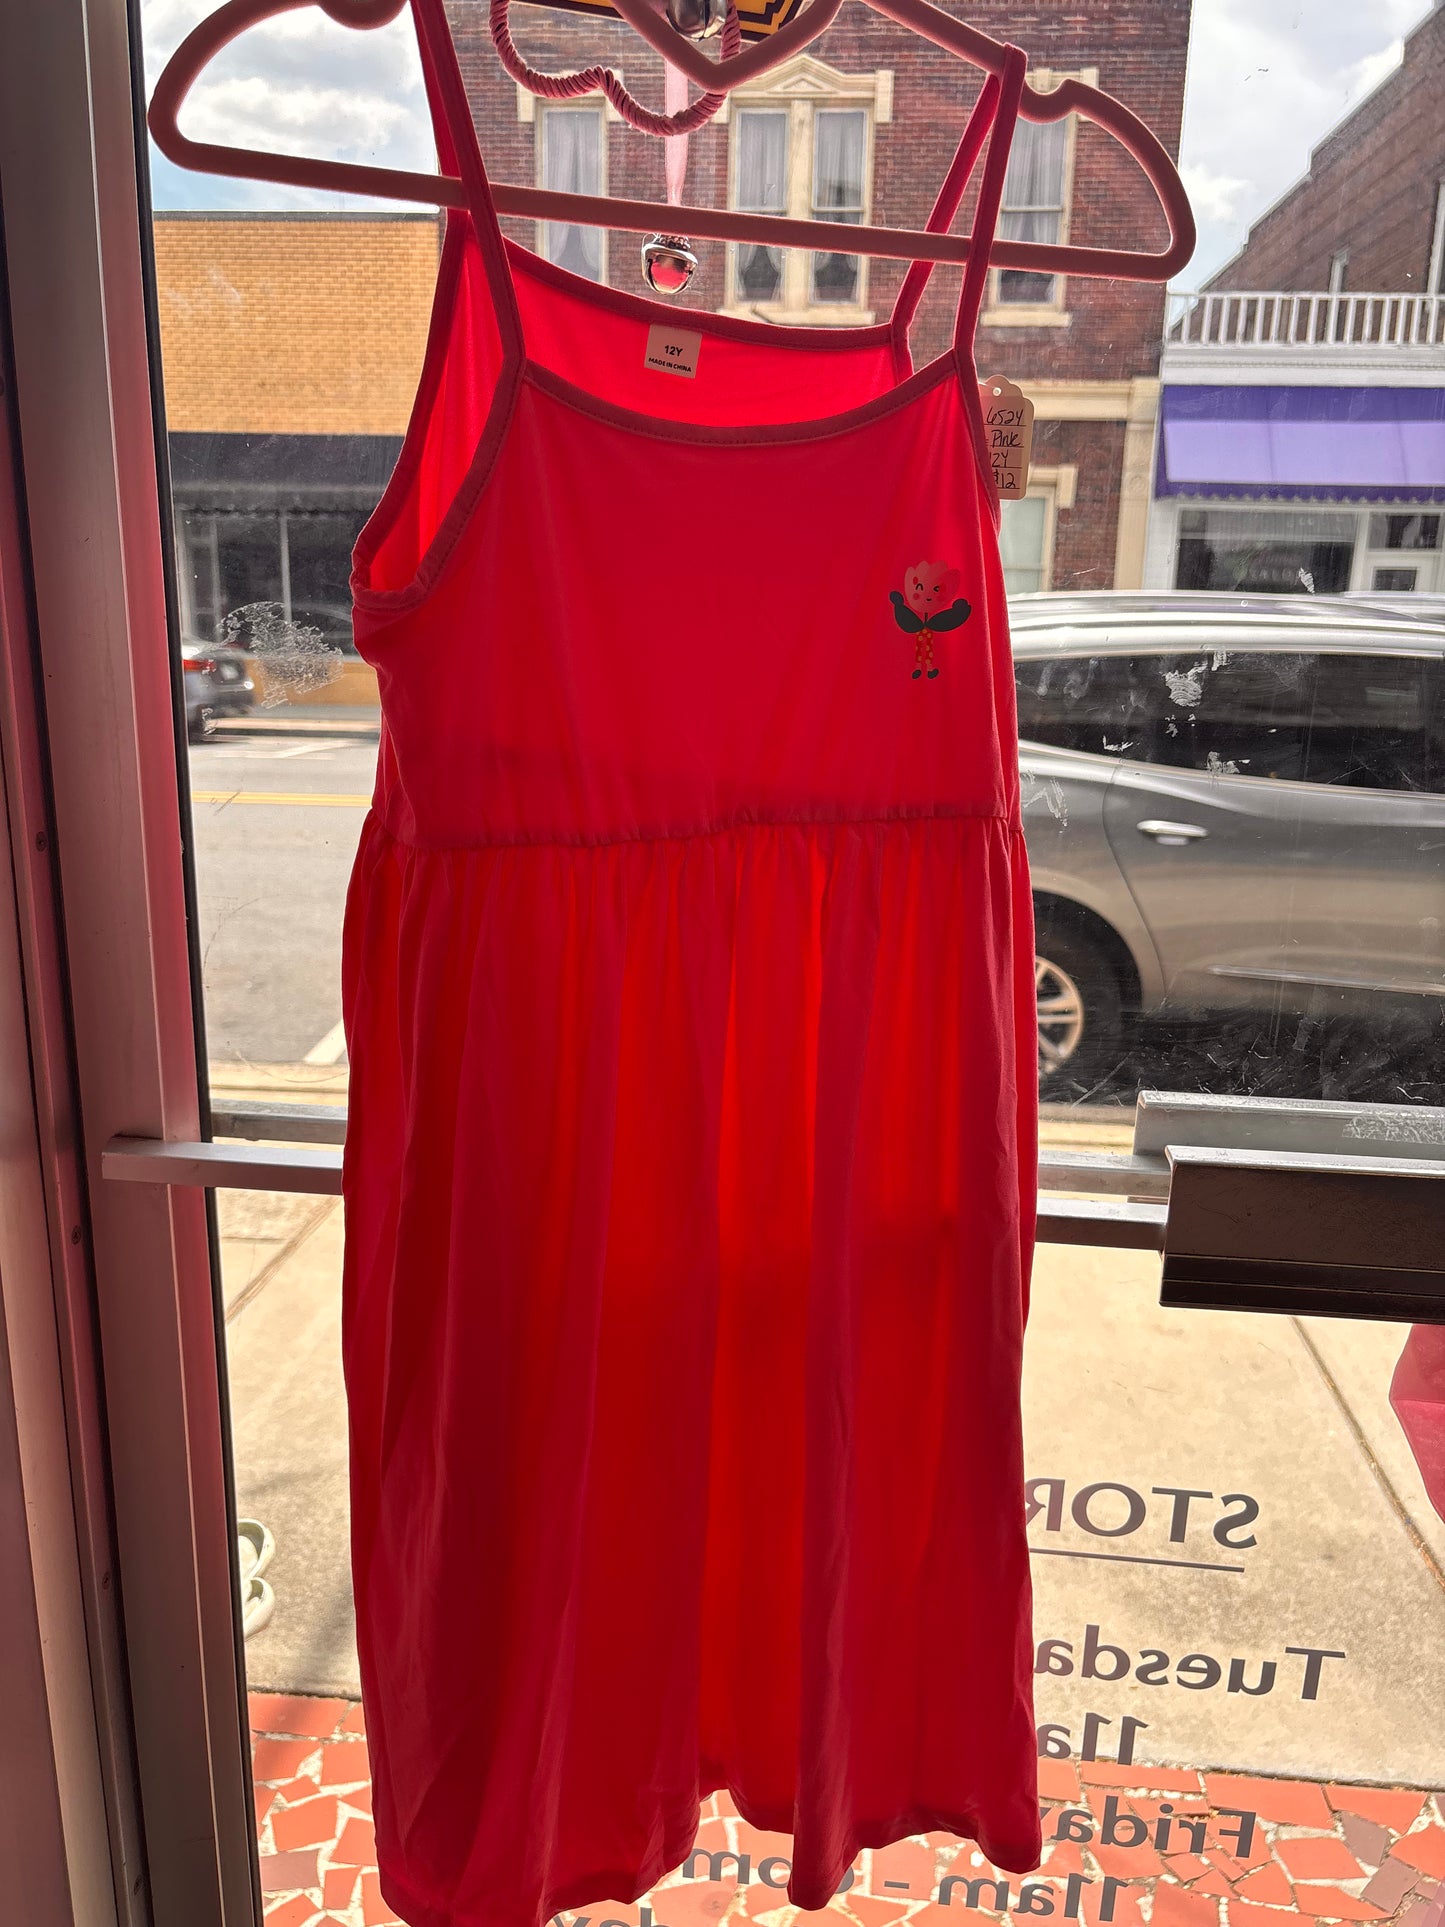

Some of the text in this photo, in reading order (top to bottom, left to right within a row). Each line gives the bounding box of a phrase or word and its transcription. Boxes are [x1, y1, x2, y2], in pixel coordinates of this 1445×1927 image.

[664, 345, 683, 357] 12Y
[649, 358, 666, 367] MADE
[673, 363, 692, 372] CHINA
